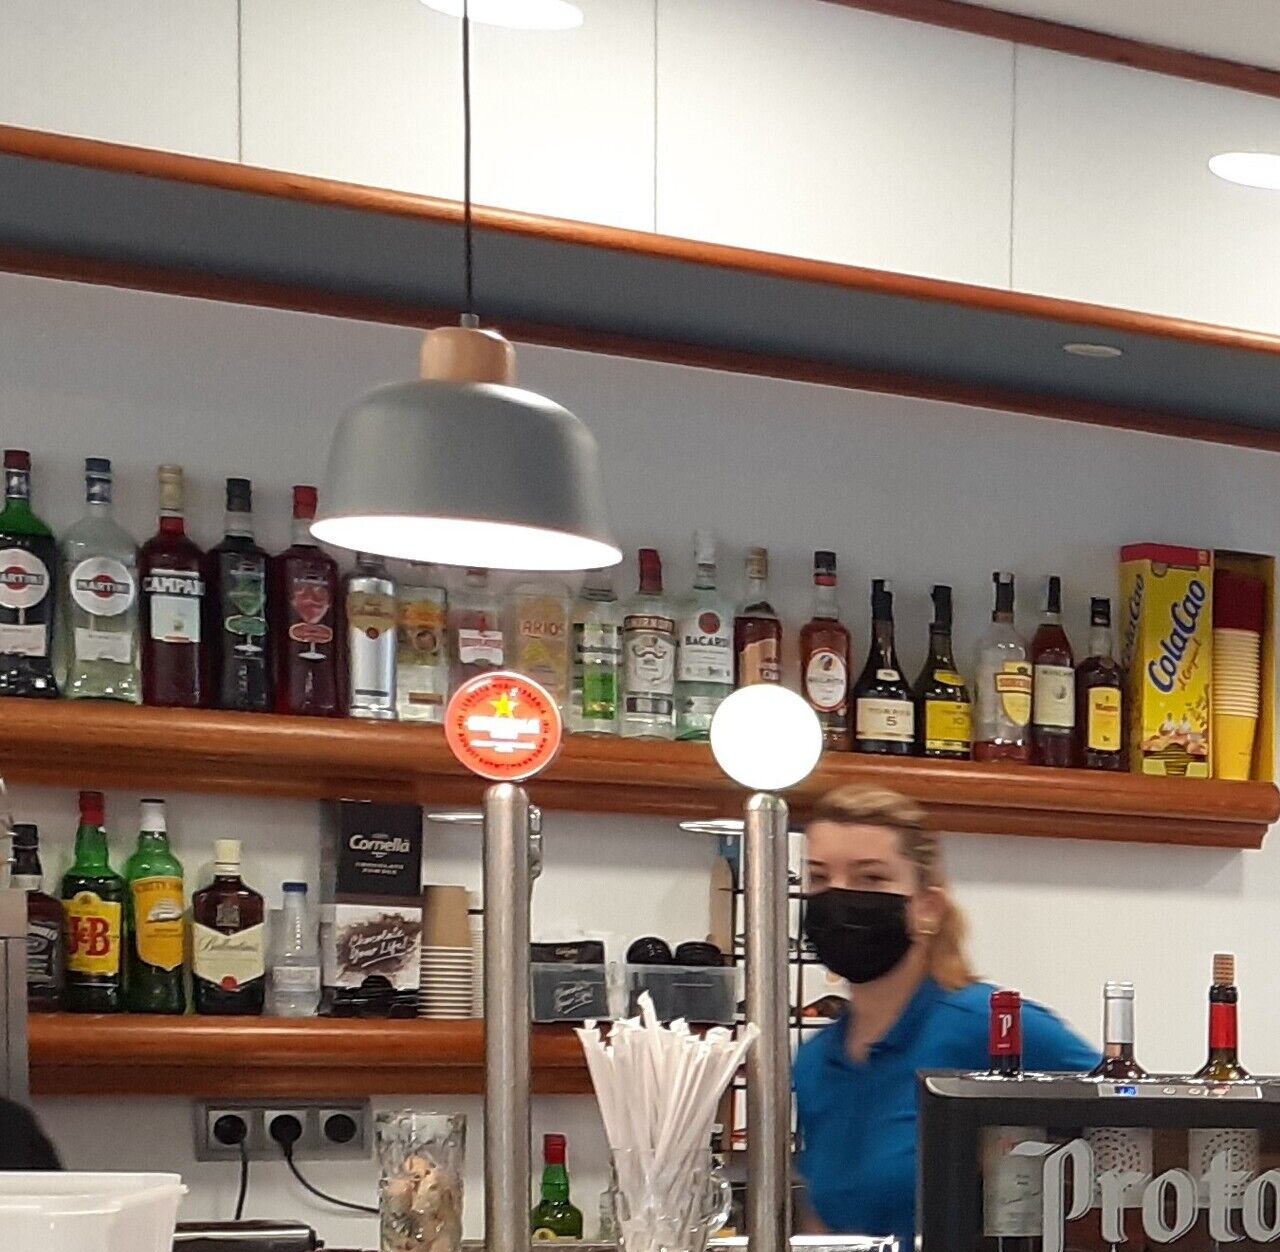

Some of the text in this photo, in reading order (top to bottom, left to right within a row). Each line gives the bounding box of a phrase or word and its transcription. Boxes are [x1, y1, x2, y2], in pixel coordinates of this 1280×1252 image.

[0, 573, 43, 585] ARTINI
[1148, 579, 1206, 693] ColaCao
[885, 715, 898, 727] 5
